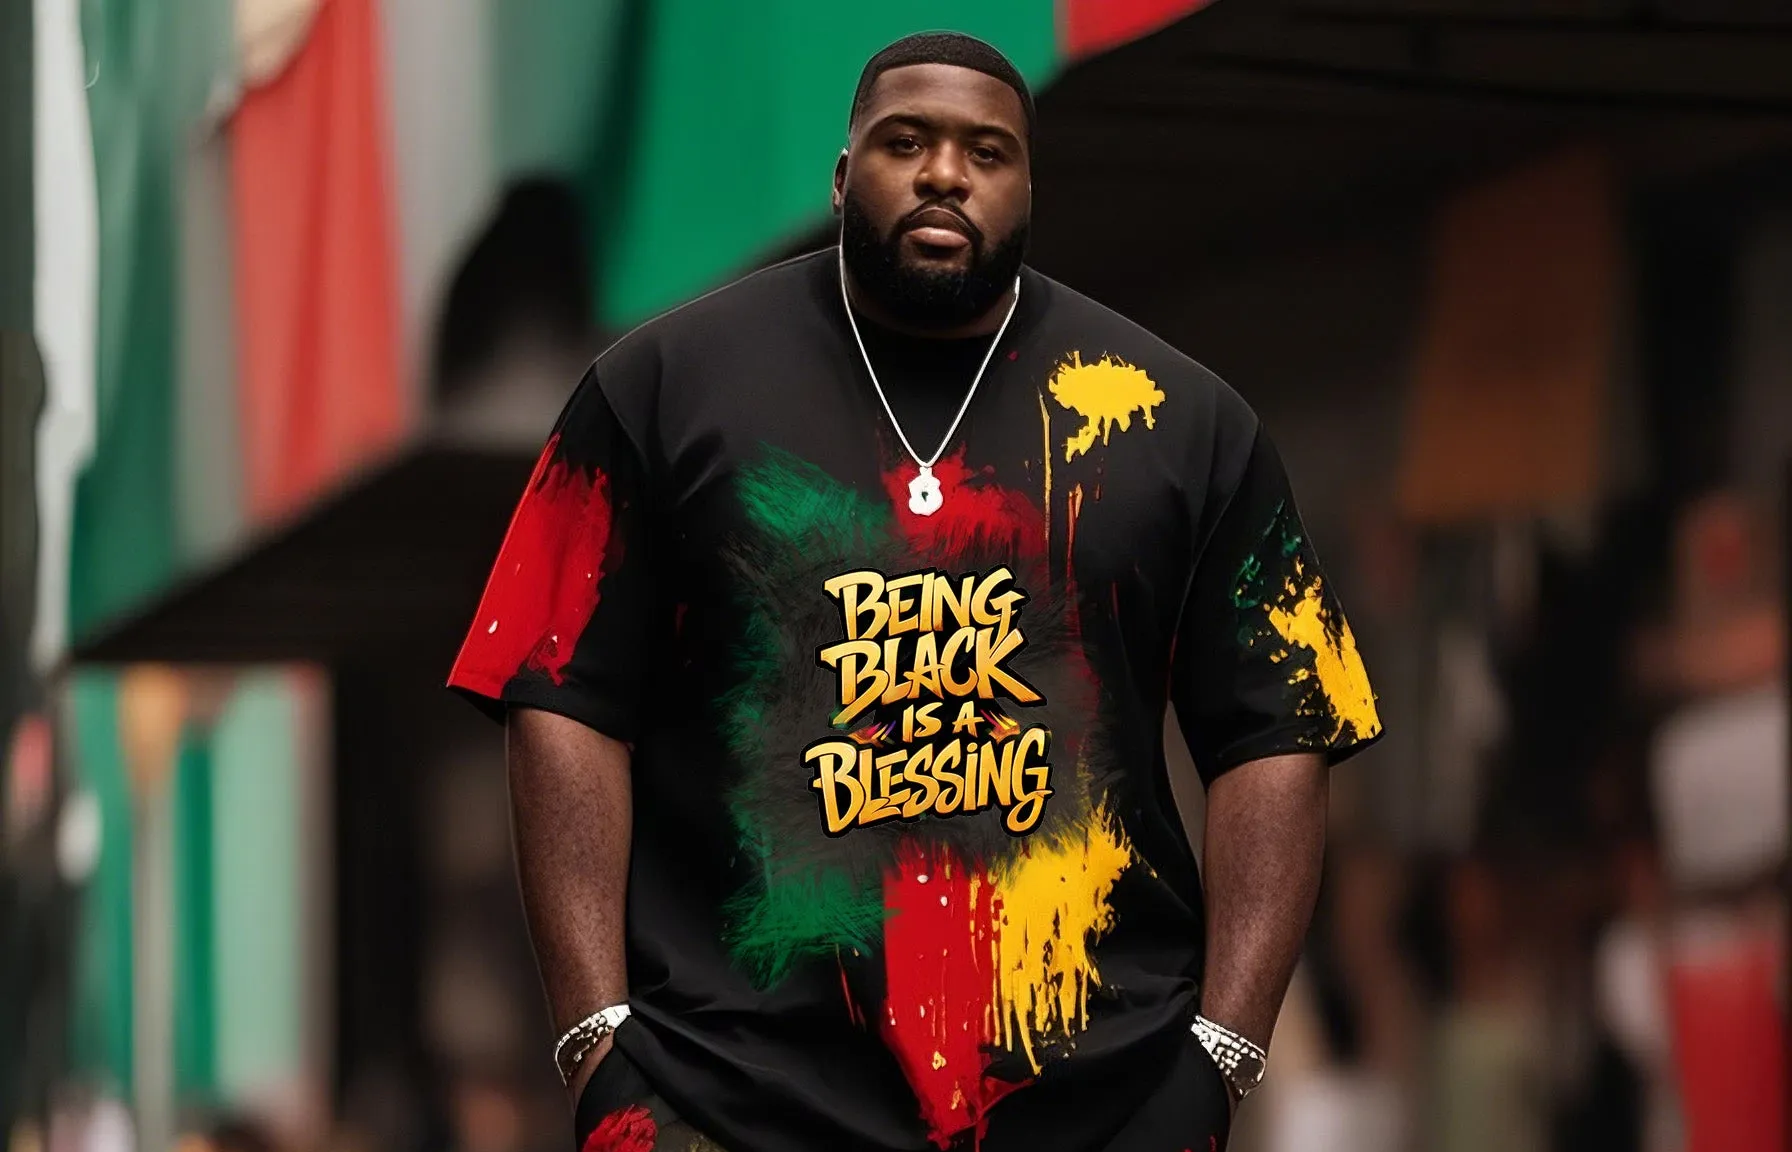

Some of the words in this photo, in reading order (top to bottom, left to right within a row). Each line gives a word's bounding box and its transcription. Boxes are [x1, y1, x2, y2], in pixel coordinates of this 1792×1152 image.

[824, 567, 1026, 650] BEING
[820, 626, 1043, 726] BLACK
[902, 701, 943, 743] IS
[952, 700, 985, 738] A
[804, 727, 1053, 833] BLESSING
